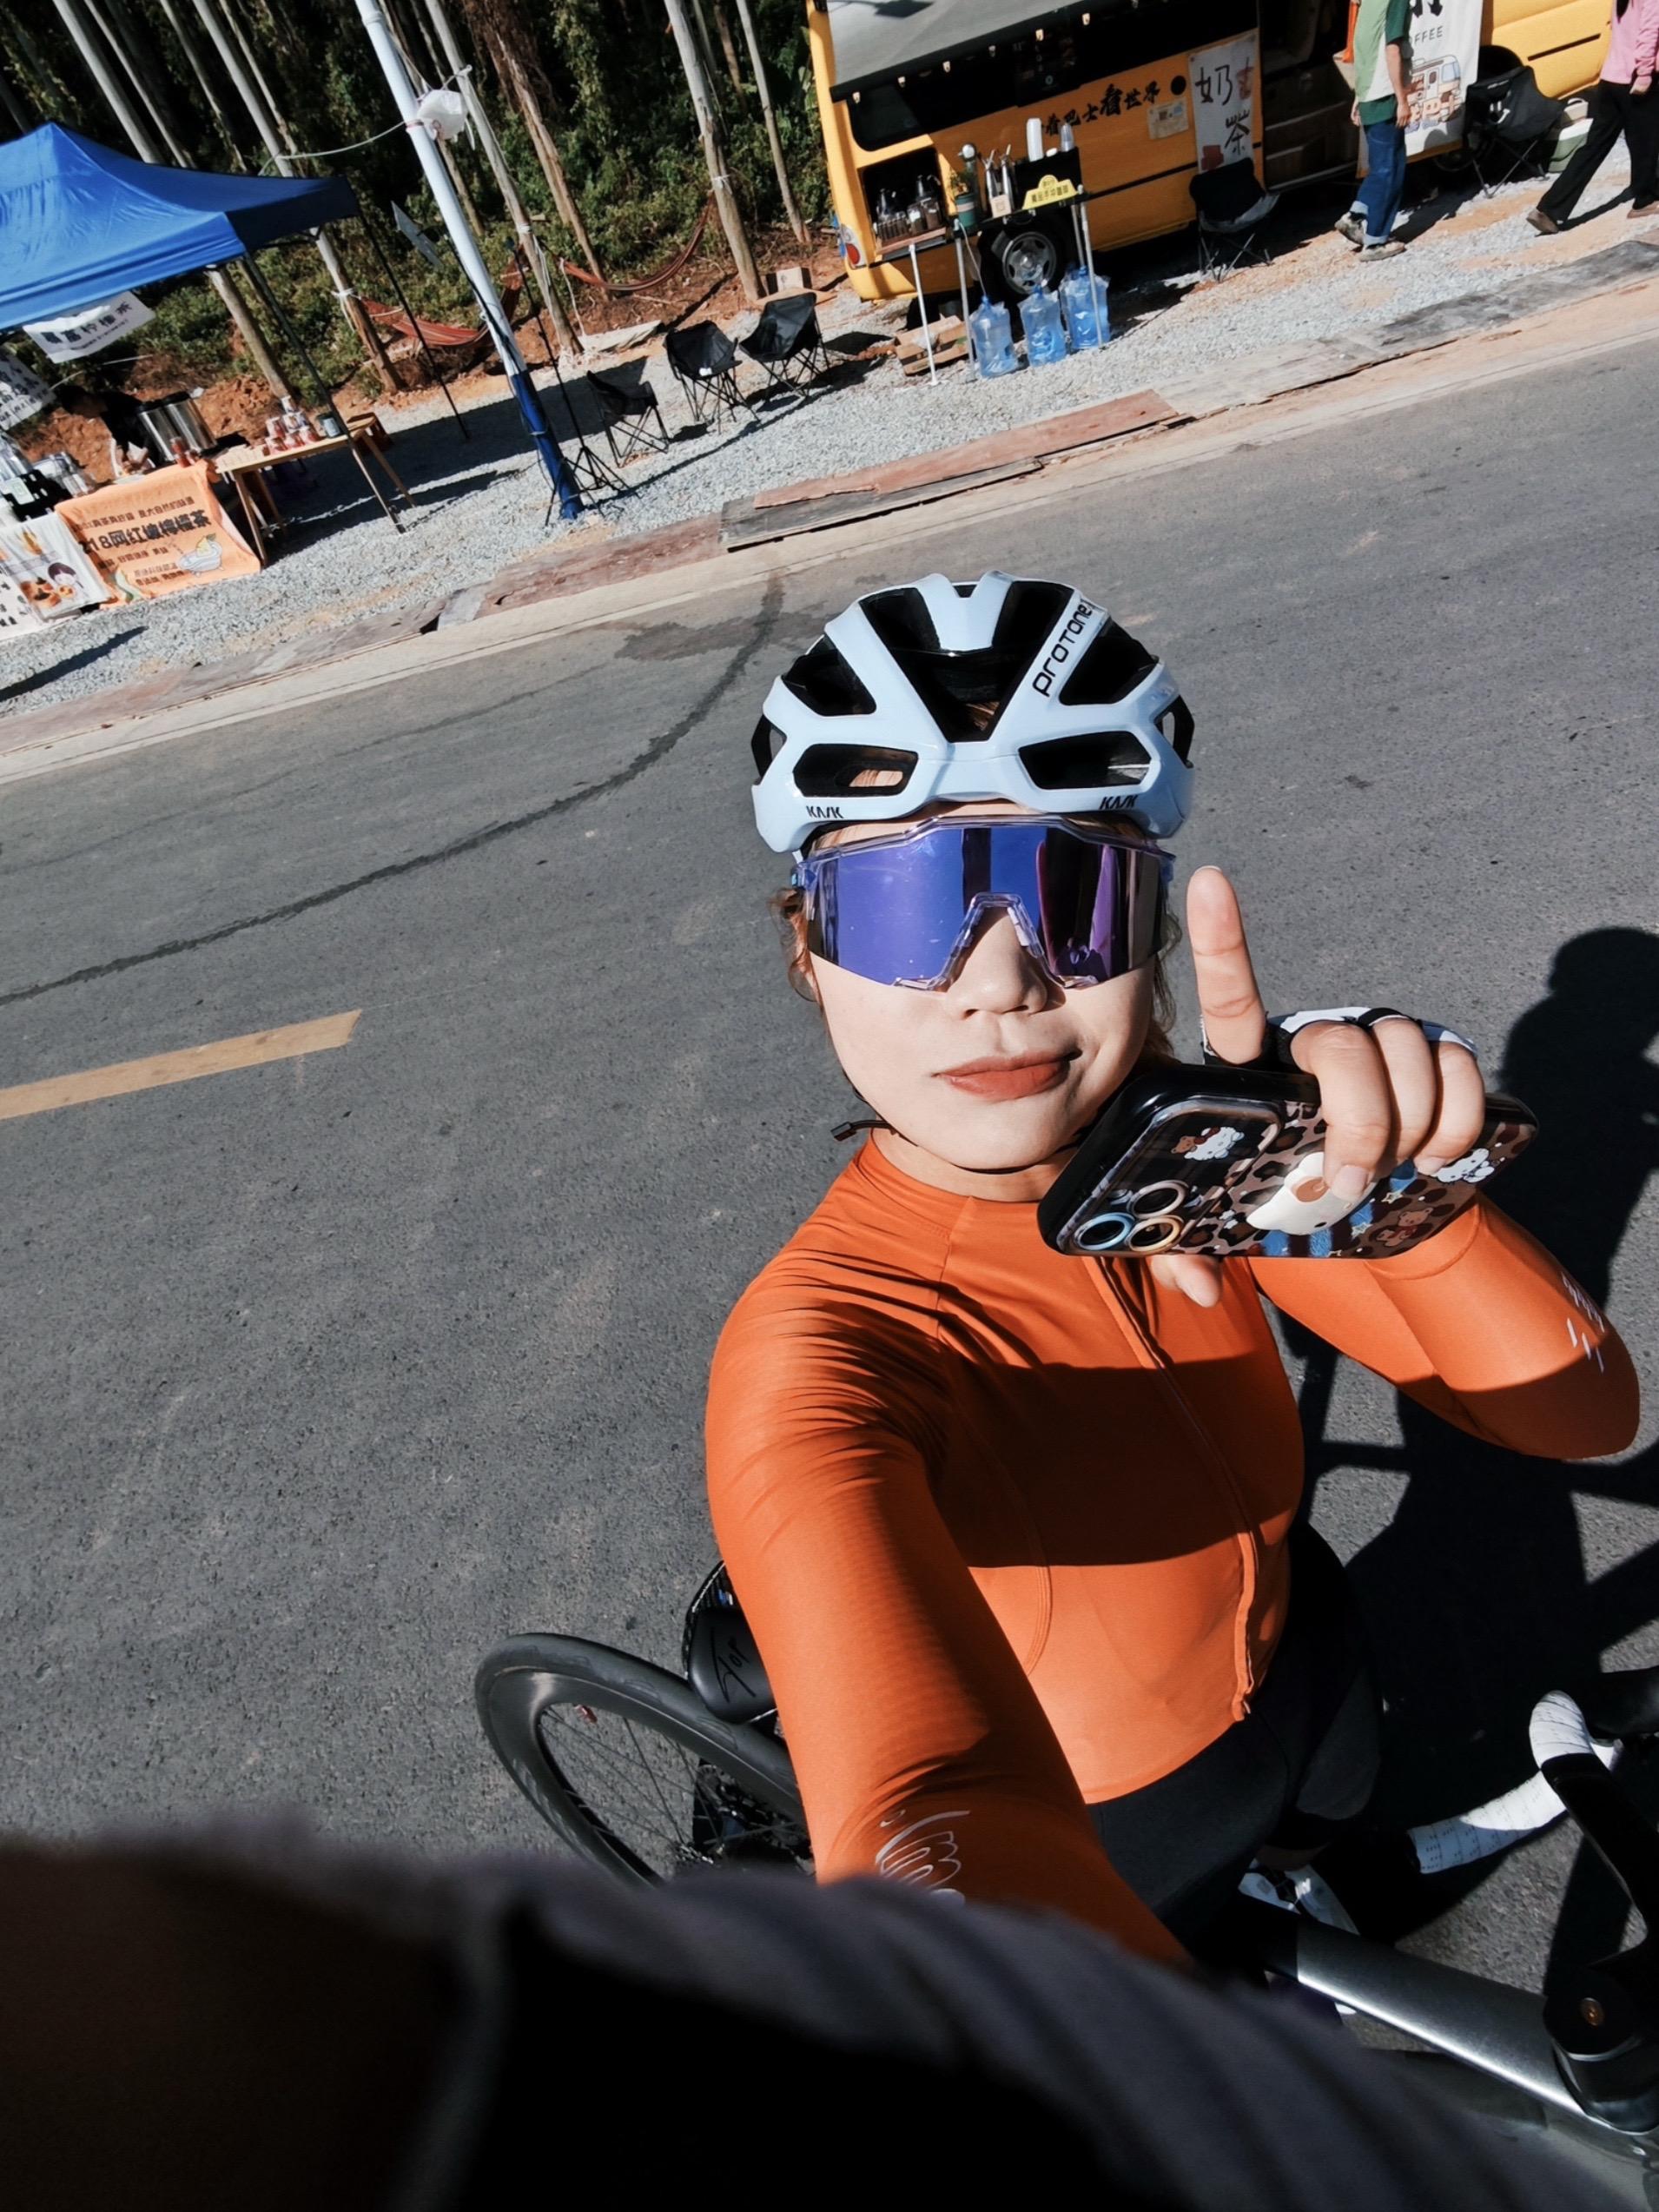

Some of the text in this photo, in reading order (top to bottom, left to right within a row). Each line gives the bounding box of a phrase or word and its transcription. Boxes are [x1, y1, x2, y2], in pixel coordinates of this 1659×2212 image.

[1410, 25, 1444, 44] FFEE
[1042, 80, 1160, 136] 着巴士看世界
[1195, 64, 1250, 156] 奶茶
